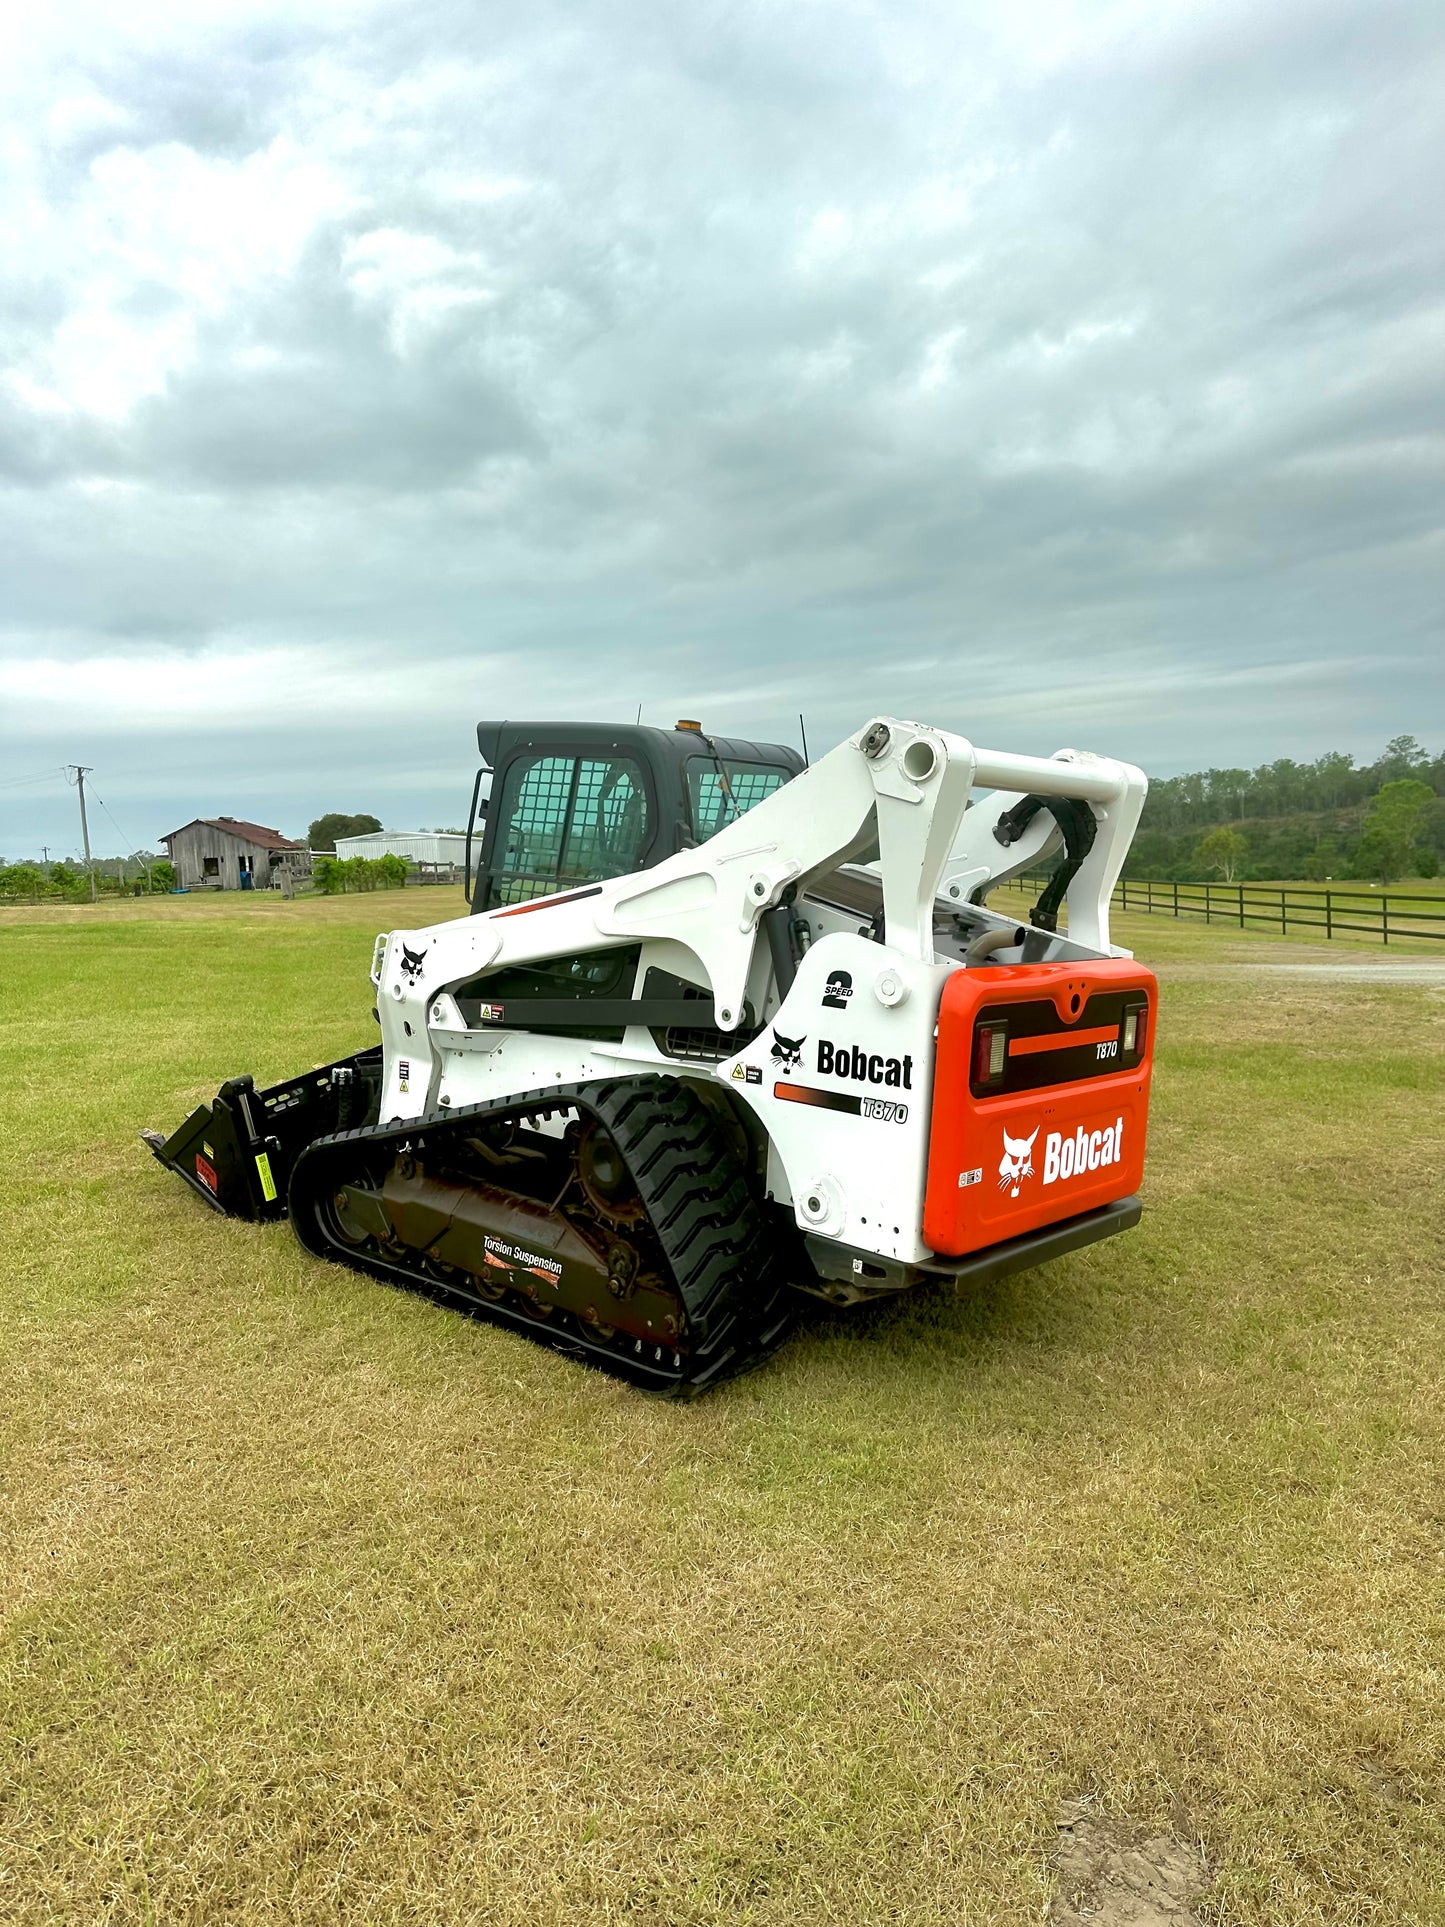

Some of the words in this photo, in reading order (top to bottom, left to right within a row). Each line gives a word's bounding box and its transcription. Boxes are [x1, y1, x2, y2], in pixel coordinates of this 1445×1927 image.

[821, 970, 853, 1009] 2
[824, 986, 853, 997] SPEED
[817, 1039, 913, 1090] Bobcat
[1096, 1041, 1118, 1060] T870
[863, 1097, 909, 1124] T870
[1043, 1117, 1123, 1185] Bobcat
[484, 1235, 512, 1255] Torsion
[513, 1246, 562, 1274] Suspension
